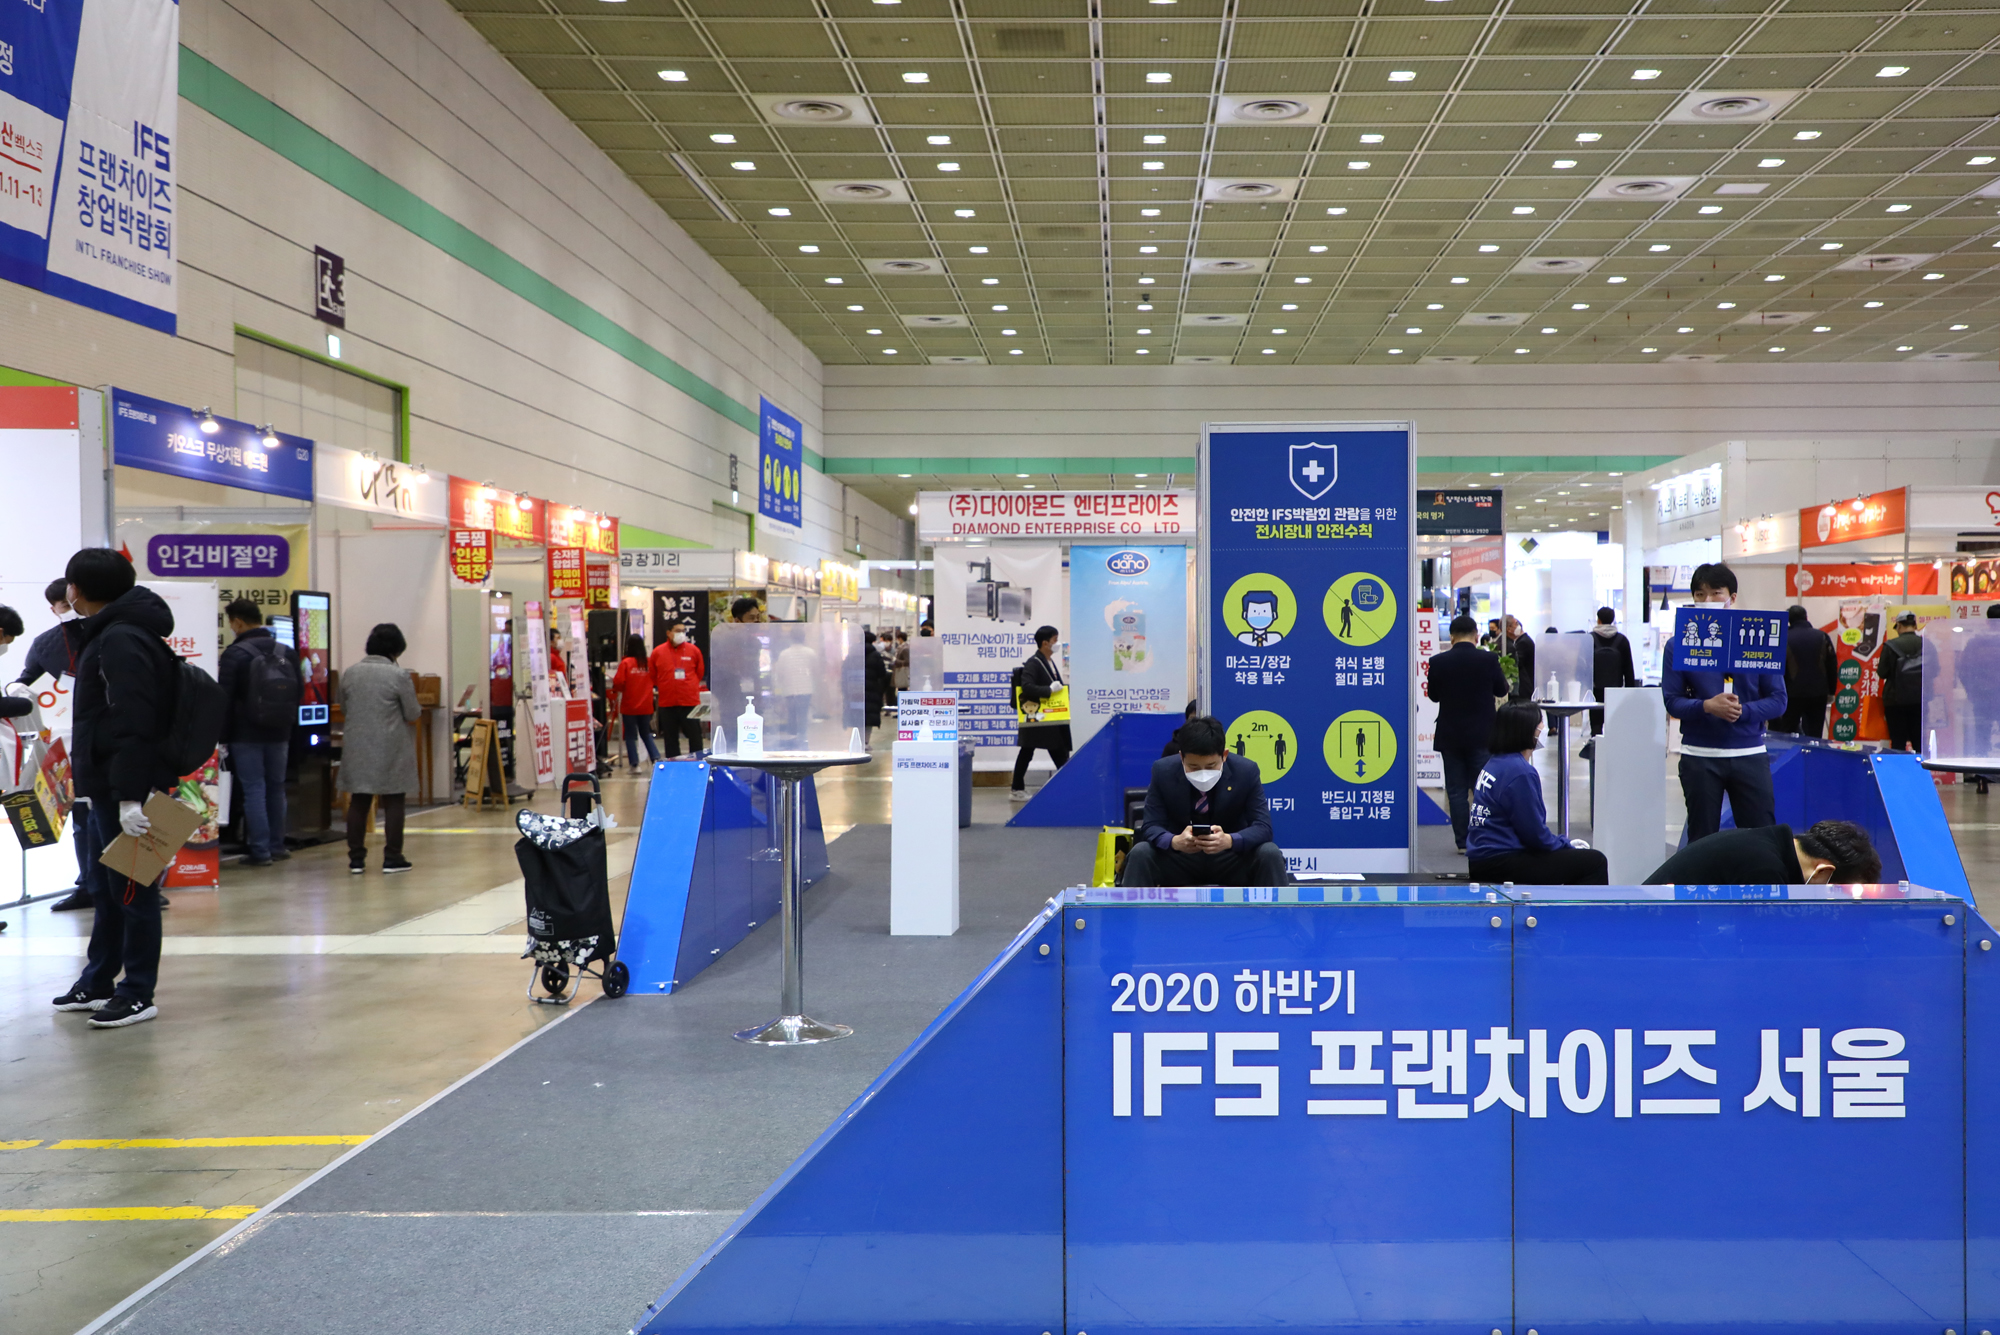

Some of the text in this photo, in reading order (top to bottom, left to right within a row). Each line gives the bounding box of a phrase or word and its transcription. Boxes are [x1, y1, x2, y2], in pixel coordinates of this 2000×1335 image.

[133, 120, 171, 172] IFS
[77, 139, 172, 215] 프랜차이즈
[77, 184, 172, 260] 창업박람회
[101, 248, 147, 278] FRANCHISE
[148, 268, 172, 287] SHOW
[337, 274, 346, 301] 3
[167, 432, 205, 457] 키오스크
[206, 441, 242, 467] 무상지원
[948, 493, 1180, 519] (주)다이아몬드 엔터프라이즈
[1230, 507, 1398, 522] 안전한 IFS박람회 관람을 위한
[1431, 511, 1445, 520] 명가
[952, 521, 1180, 535] DIAMOND ENTERPRISE CO LTD
[1255, 524, 1373, 540] 전시장내 안전수칙
[455, 531, 486, 547] 두찜
[157, 544, 279, 570] 인건비절약
[456, 547, 487, 564] 인생
[456, 564, 487, 580] 역전
[977, 646, 1023, 659] 휘핑 머신!
[1690, 648, 1713, 657] 마스크
[1742, 650, 1773, 660] 거리두기
[1226, 655, 1292, 669] 마스크/장갑
[1335, 656, 1385, 670] 취식 보행
[1700, 658, 1718, 667] 필수!
[982, 673, 998, 683] 위한
[1235, 671, 1286, 685] 착용 필수
[1335, 672, 1385, 686] 절대 금지
[1087, 688, 1170, 701] 알프스의 건강함을
[1091, 702, 1111, 714] 담은
[1251, 722, 1269, 732] 2m
[1322, 790, 1395, 804] 반드시 지정된
[1329, 806, 1392, 820] 출입구 사용
[1305, 857, 1318, 872] 시
[1110, 969, 1357, 1015] 2020 하반기
[1112, 1026, 1907, 1119] IFS 프랜차이즈 서울
